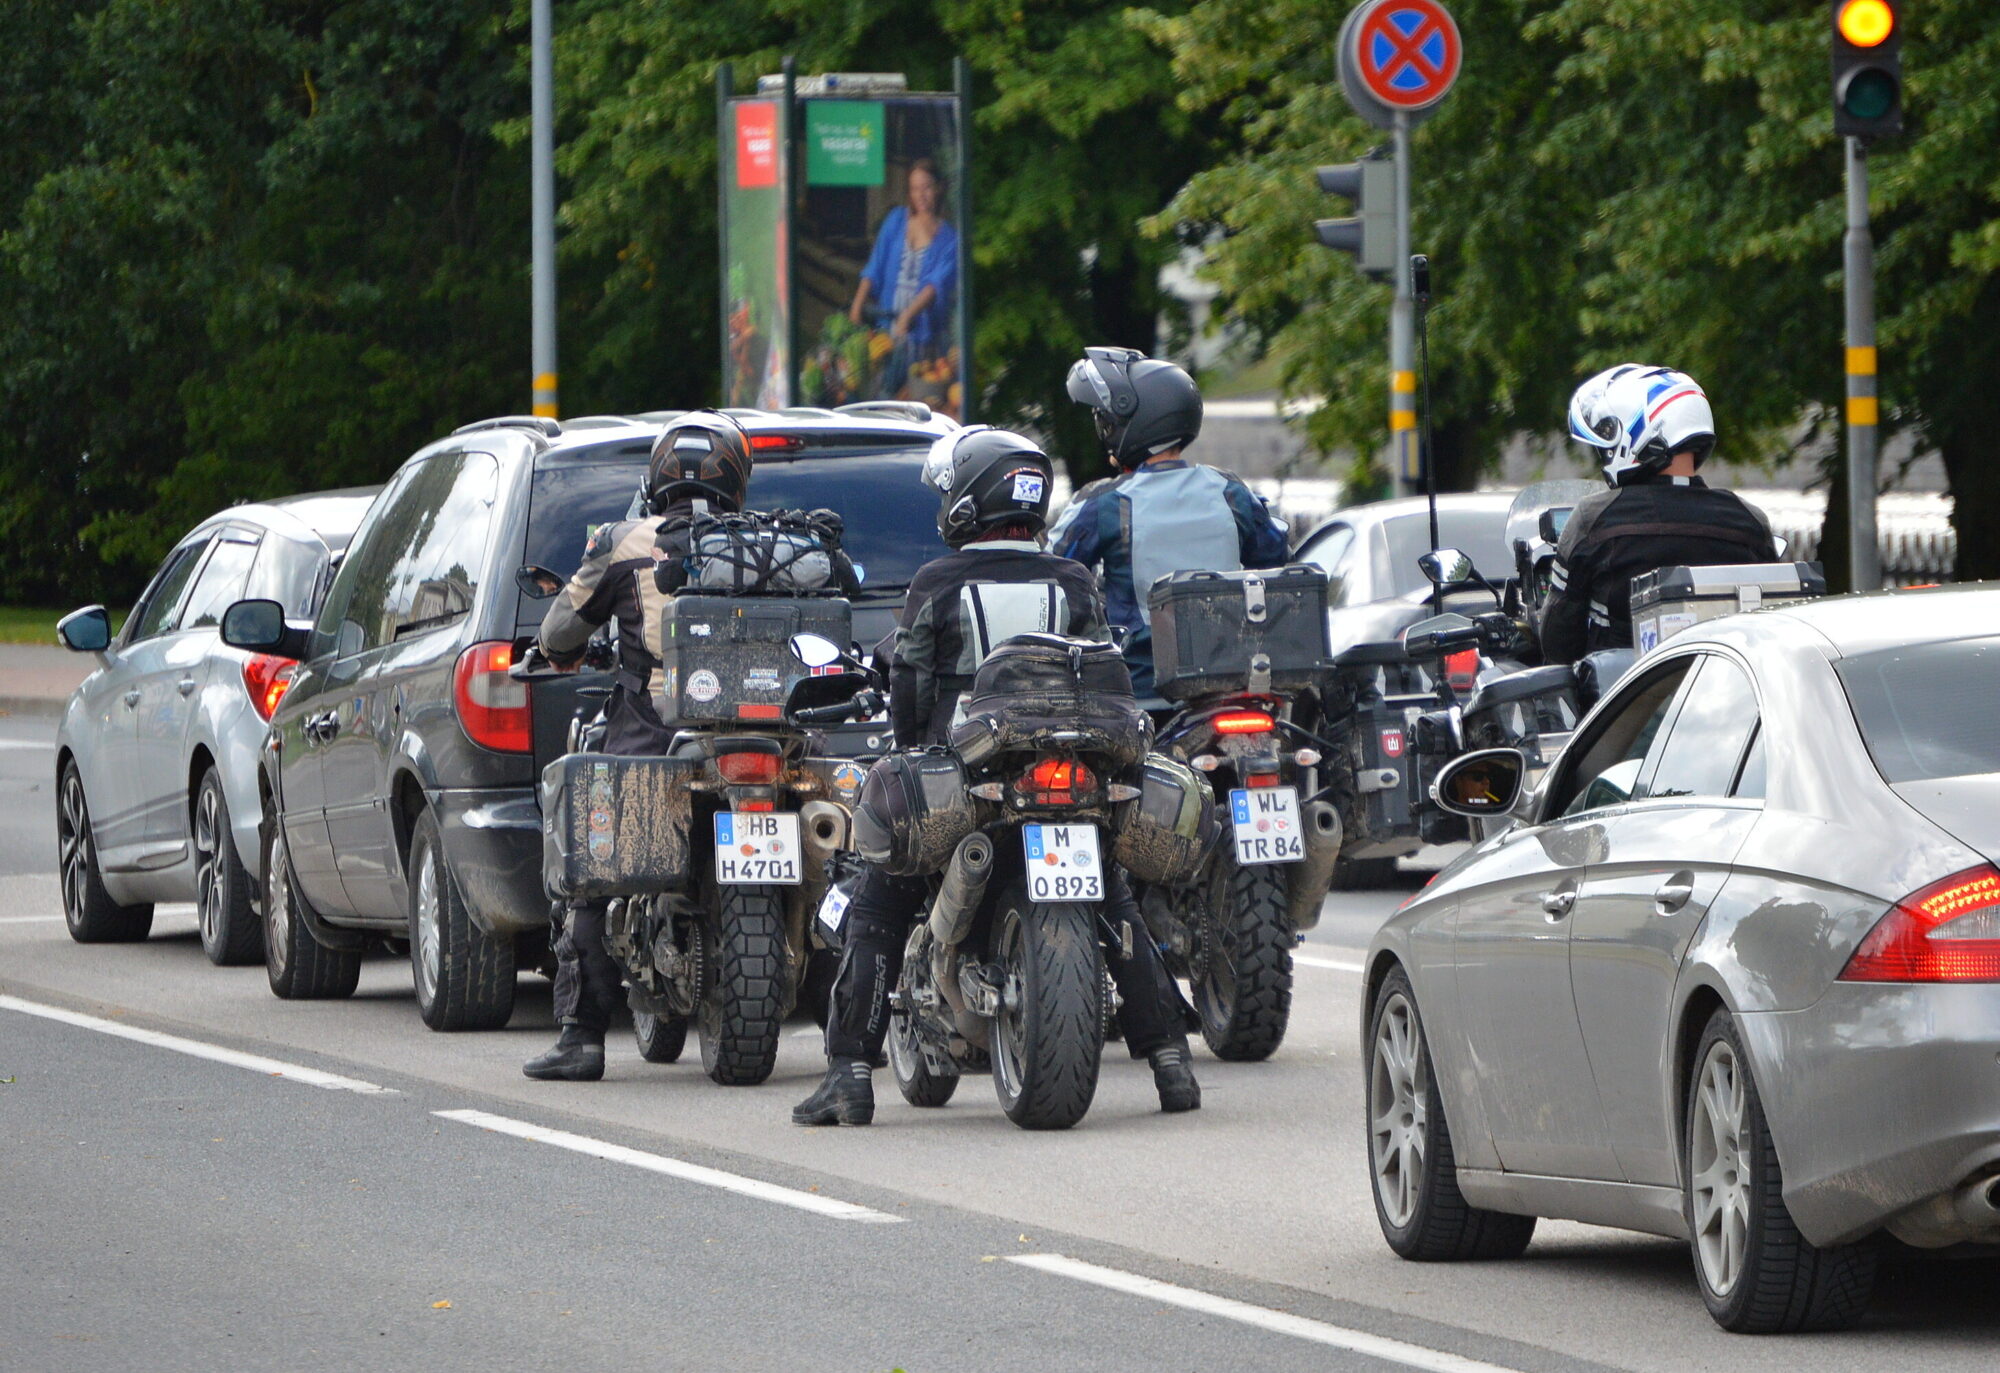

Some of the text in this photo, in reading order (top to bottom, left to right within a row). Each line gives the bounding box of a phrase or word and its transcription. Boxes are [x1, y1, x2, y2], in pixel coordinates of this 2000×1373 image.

[1257, 793, 1286, 813] WL
[750, 816, 778, 836] HB
[721, 832, 729, 842] D
[1054, 827, 1070, 848] M
[1031, 846, 1040, 856] D
[1240, 836, 1302, 859] TR 84
[722, 860, 796, 879] H 4701
[1055, 876, 1099, 897] 893
[866, 953, 887, 1034] MODEKA
